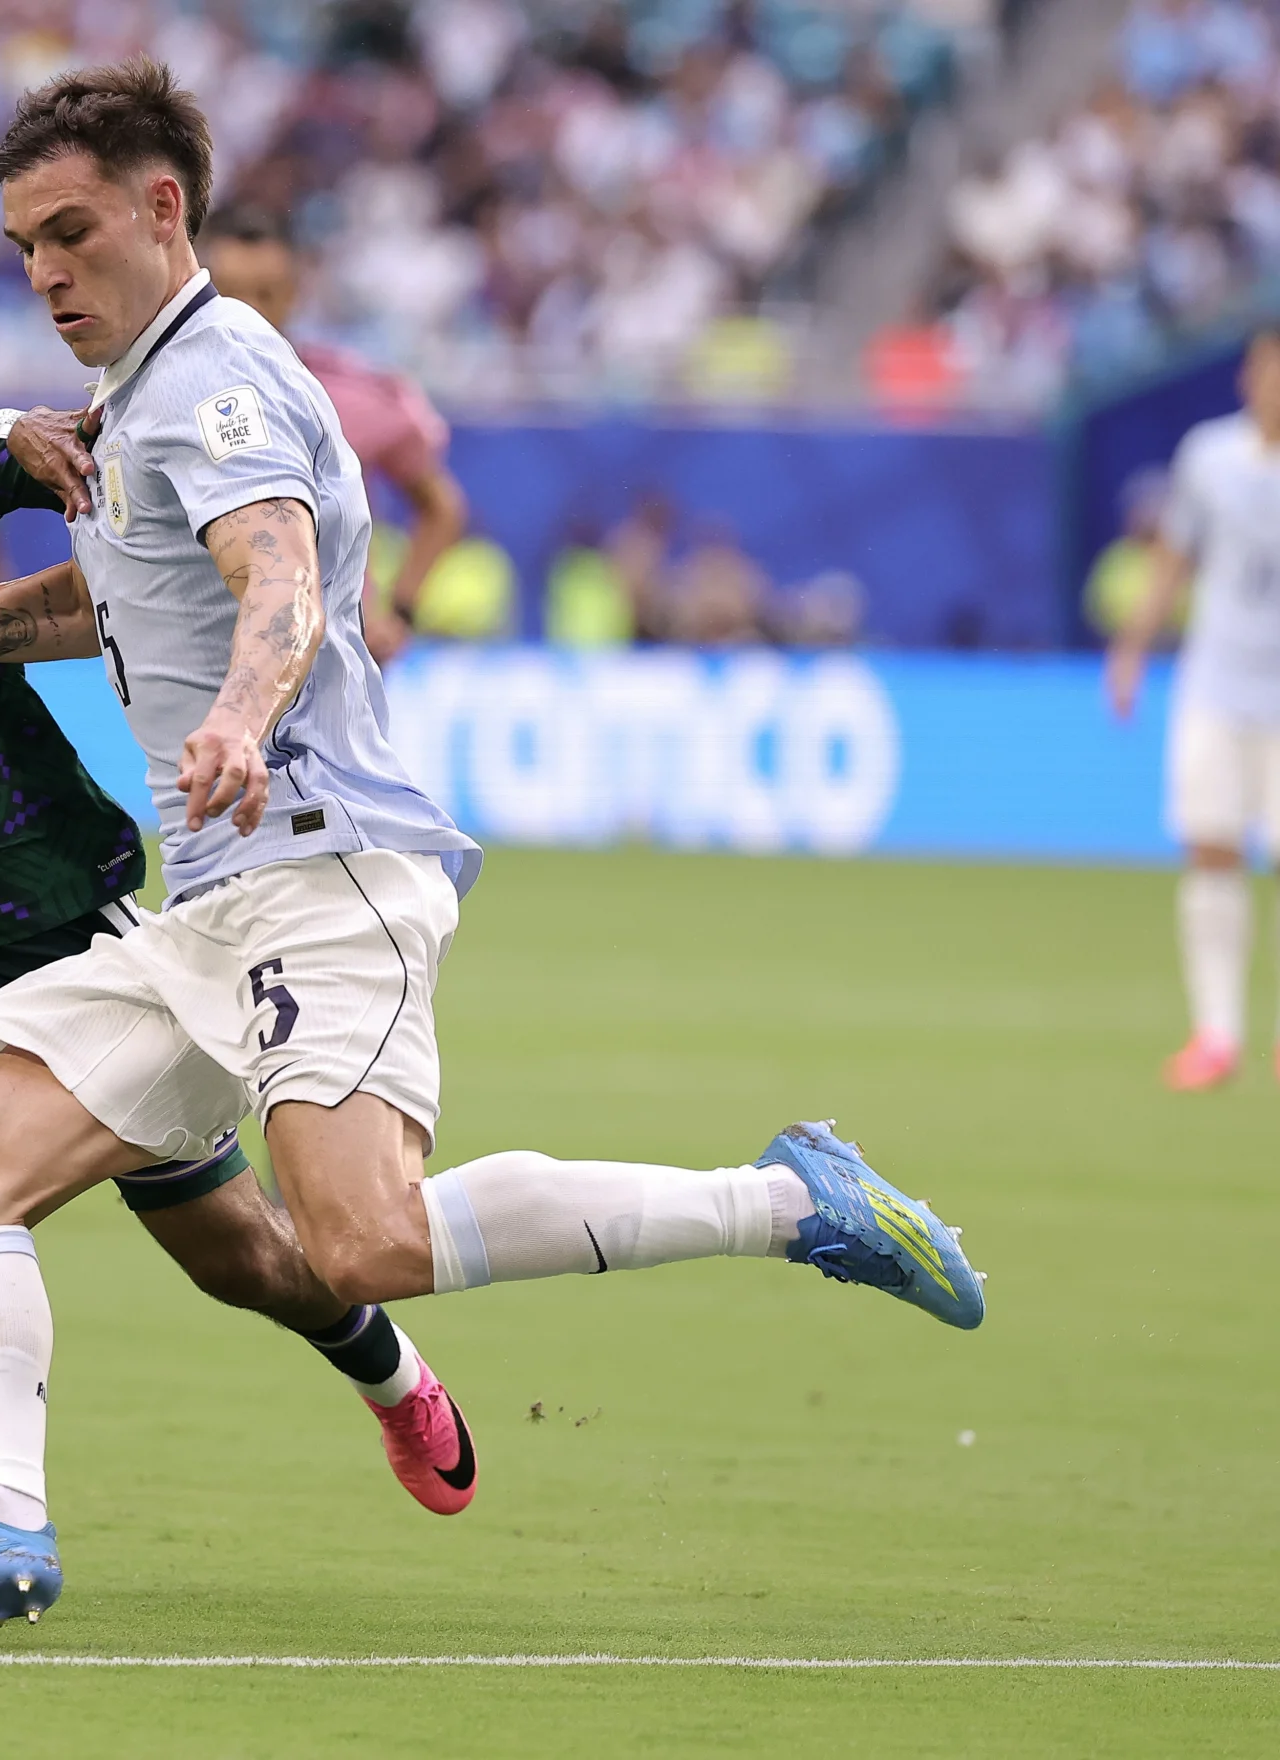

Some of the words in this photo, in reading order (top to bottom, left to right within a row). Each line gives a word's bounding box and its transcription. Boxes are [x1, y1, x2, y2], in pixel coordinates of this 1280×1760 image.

[220, 425, 252, 443] PEACE
[229, 438, 247, 447] FIFA
[96, 600, 131, 708] 5
[248, 957, 300, 1052] 5
